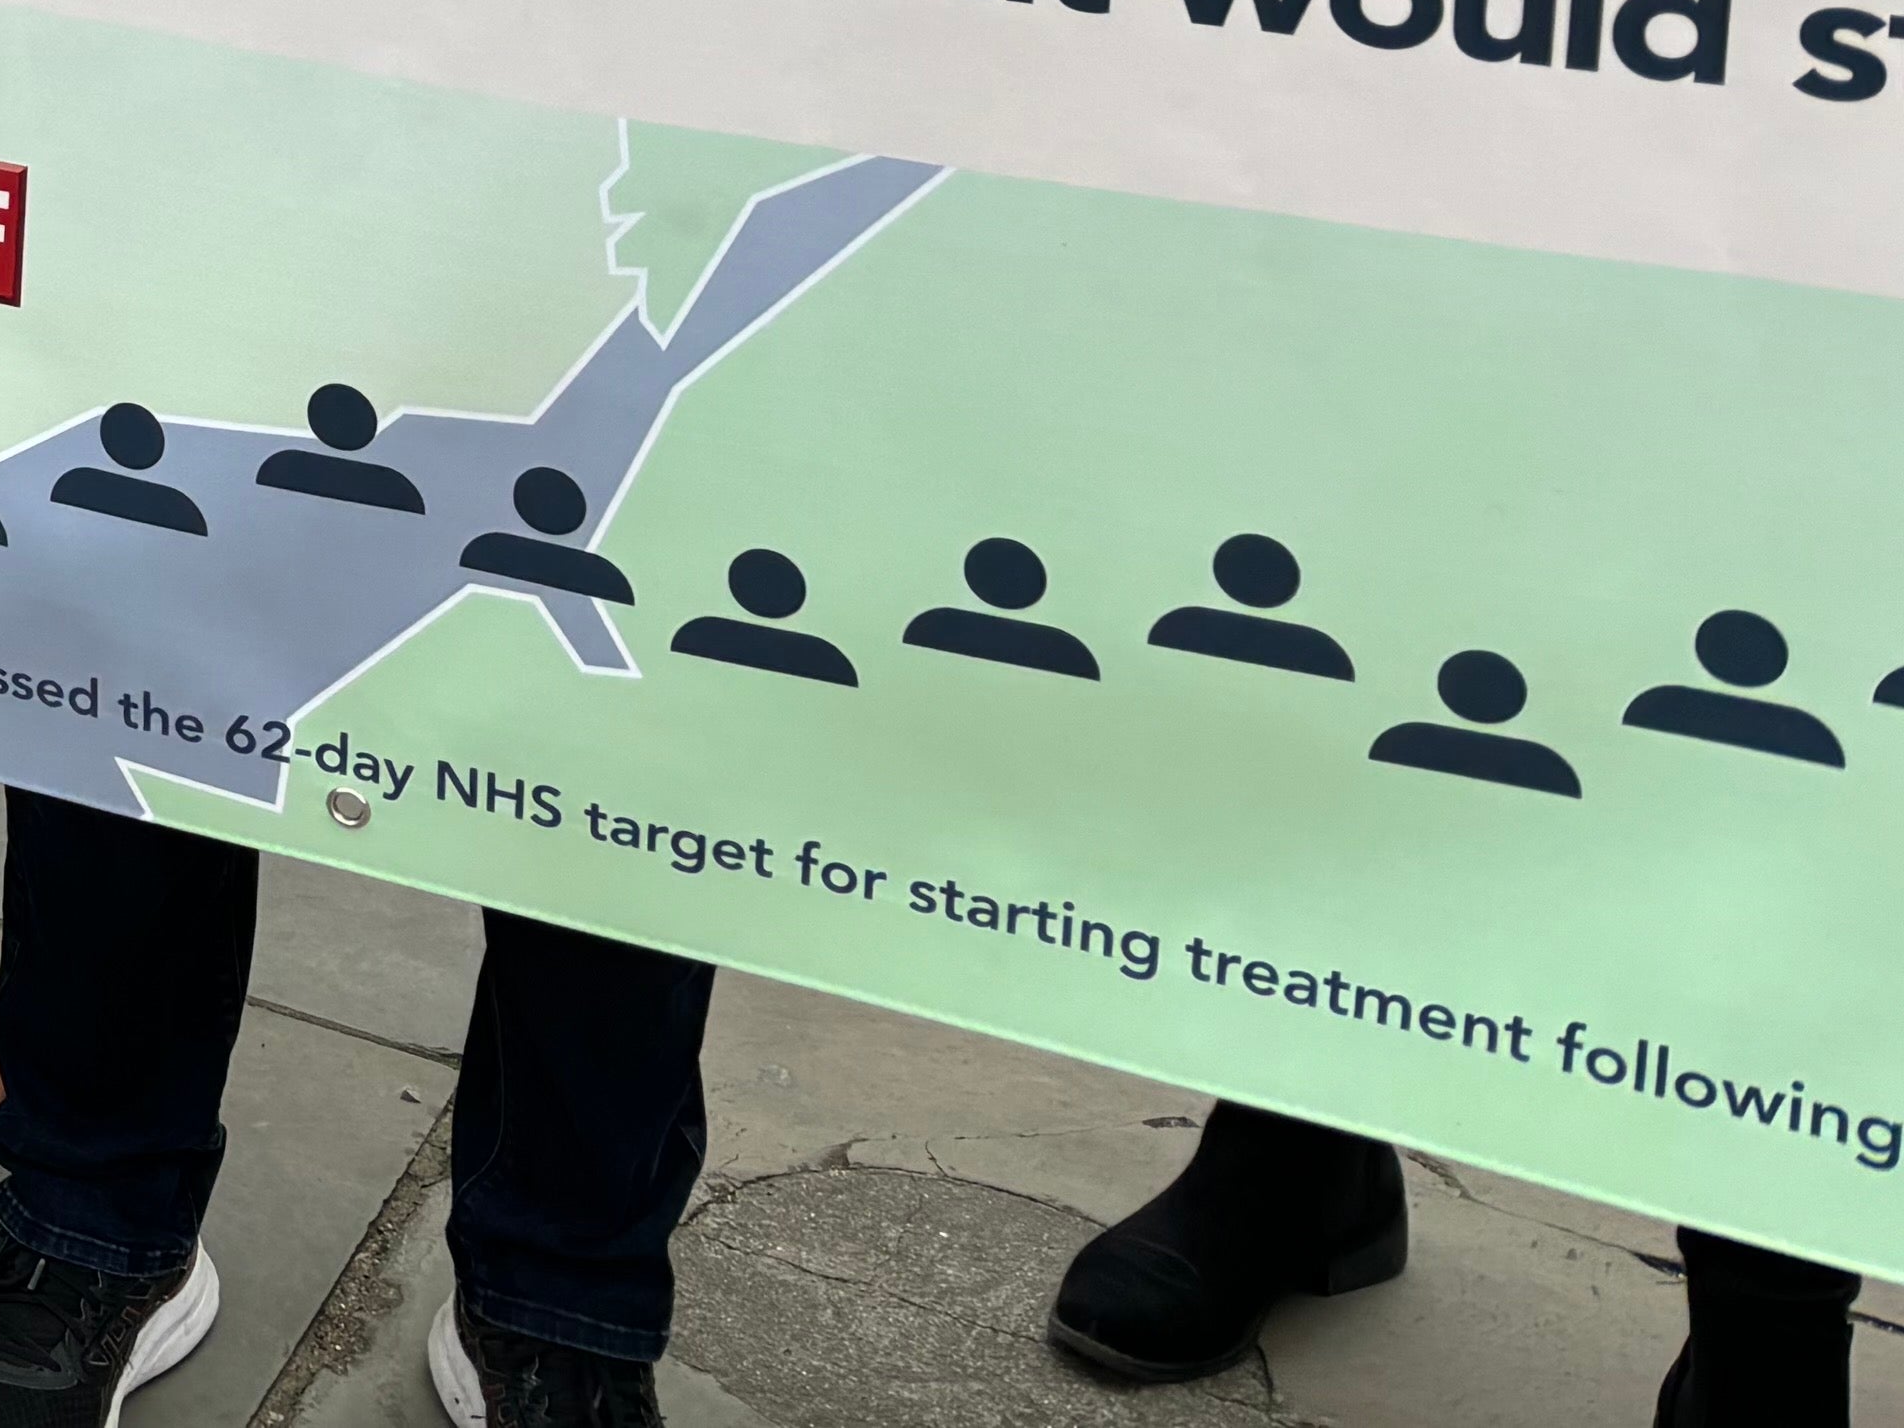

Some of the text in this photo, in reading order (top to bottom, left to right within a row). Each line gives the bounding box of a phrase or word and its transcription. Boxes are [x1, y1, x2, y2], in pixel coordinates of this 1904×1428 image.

[117, 690, 205, 743] the
[224, 715, 415, 800] 62-day
[435, 759, 563, 829] NHS
[583, 801, 774, 874] target
[794, 840, 888, 901] for
[908, 878, 1161, 981] starting
[1185, 937, 1533, 1063] treatment
[1556, 1021, 1903, 1172] following
